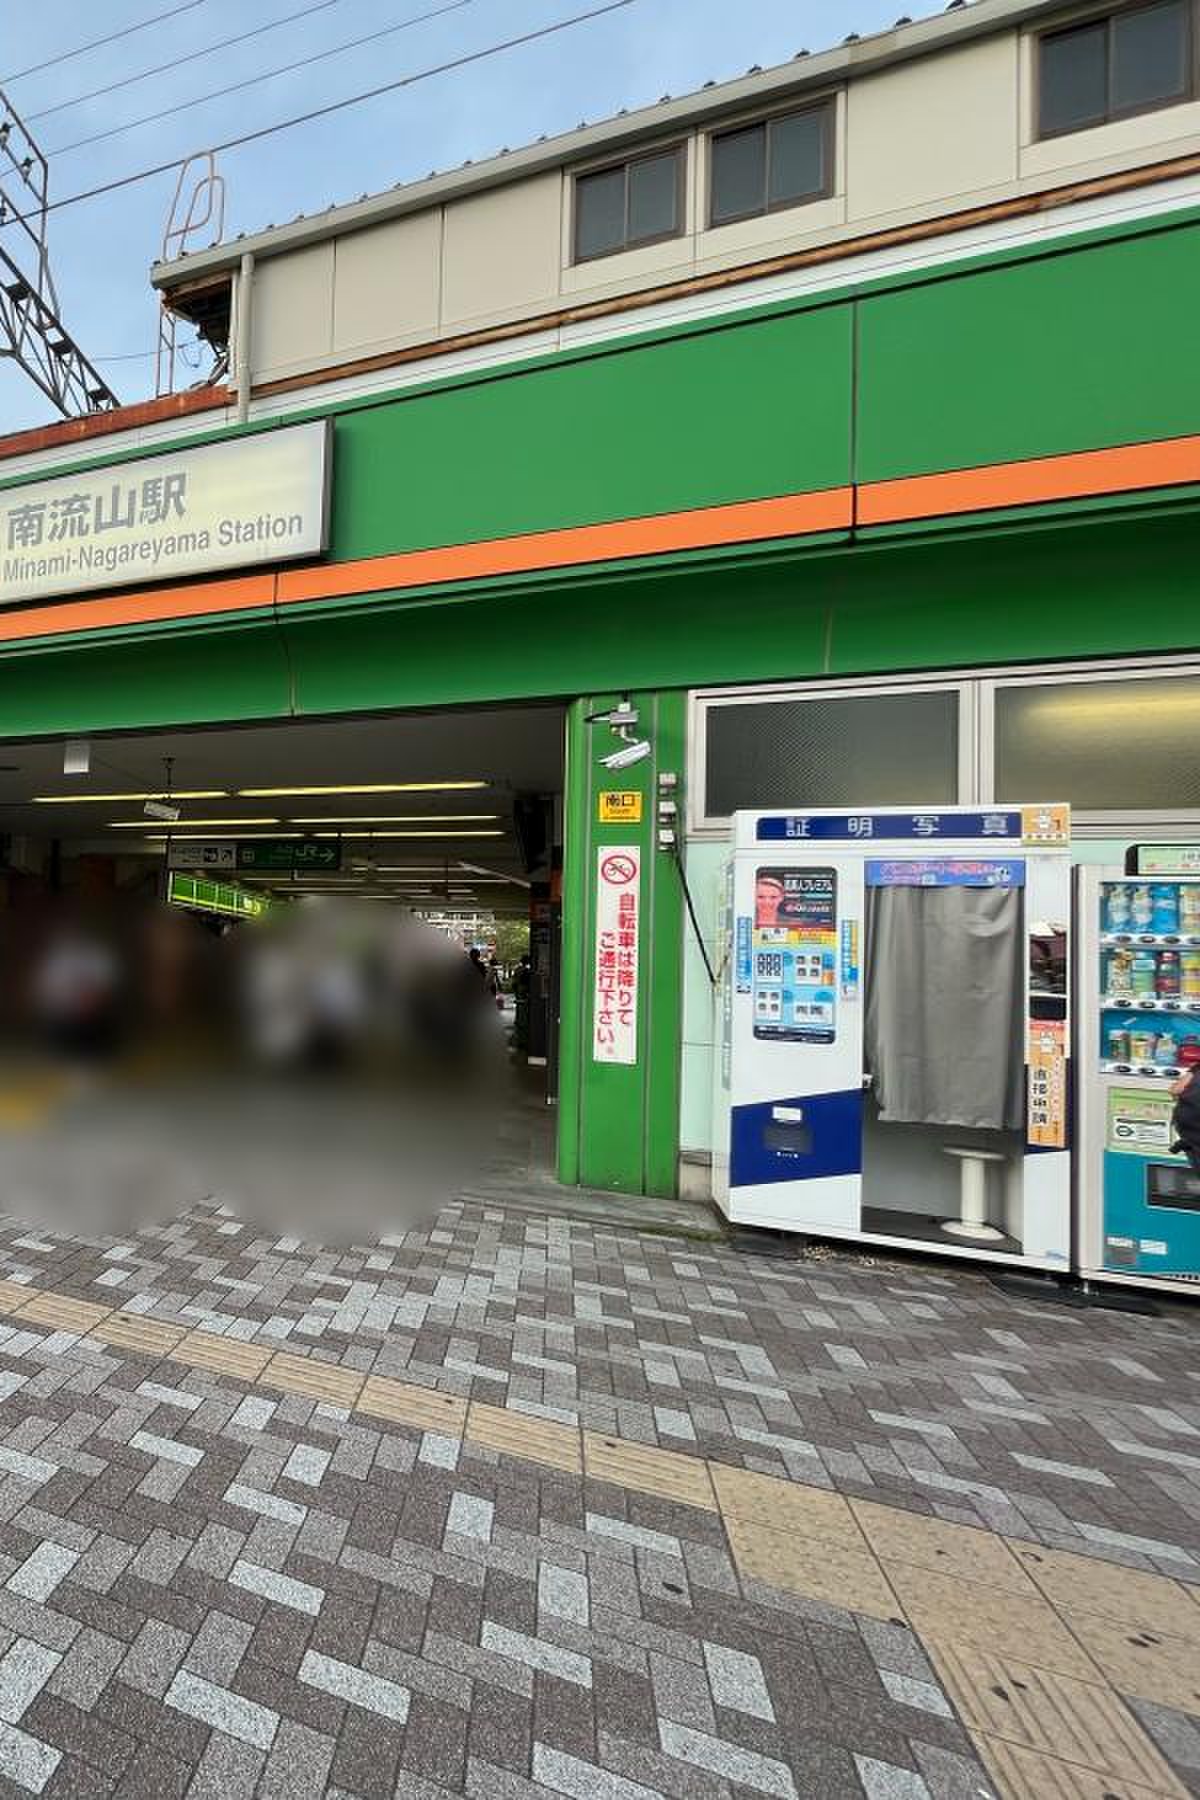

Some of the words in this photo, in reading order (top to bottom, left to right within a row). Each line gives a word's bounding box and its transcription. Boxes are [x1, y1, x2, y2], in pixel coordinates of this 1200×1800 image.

[7, 472, 187, 550] 南流山駅
[3, 529, 209, 582] Minami-Nagareyama
[218, 513, 303, 547] Station
[606, 793, 635, 808] 南口
[785, 814, 1008, 838] 証明写真
[617, 892, 636, 1026] 自転車は降りて
